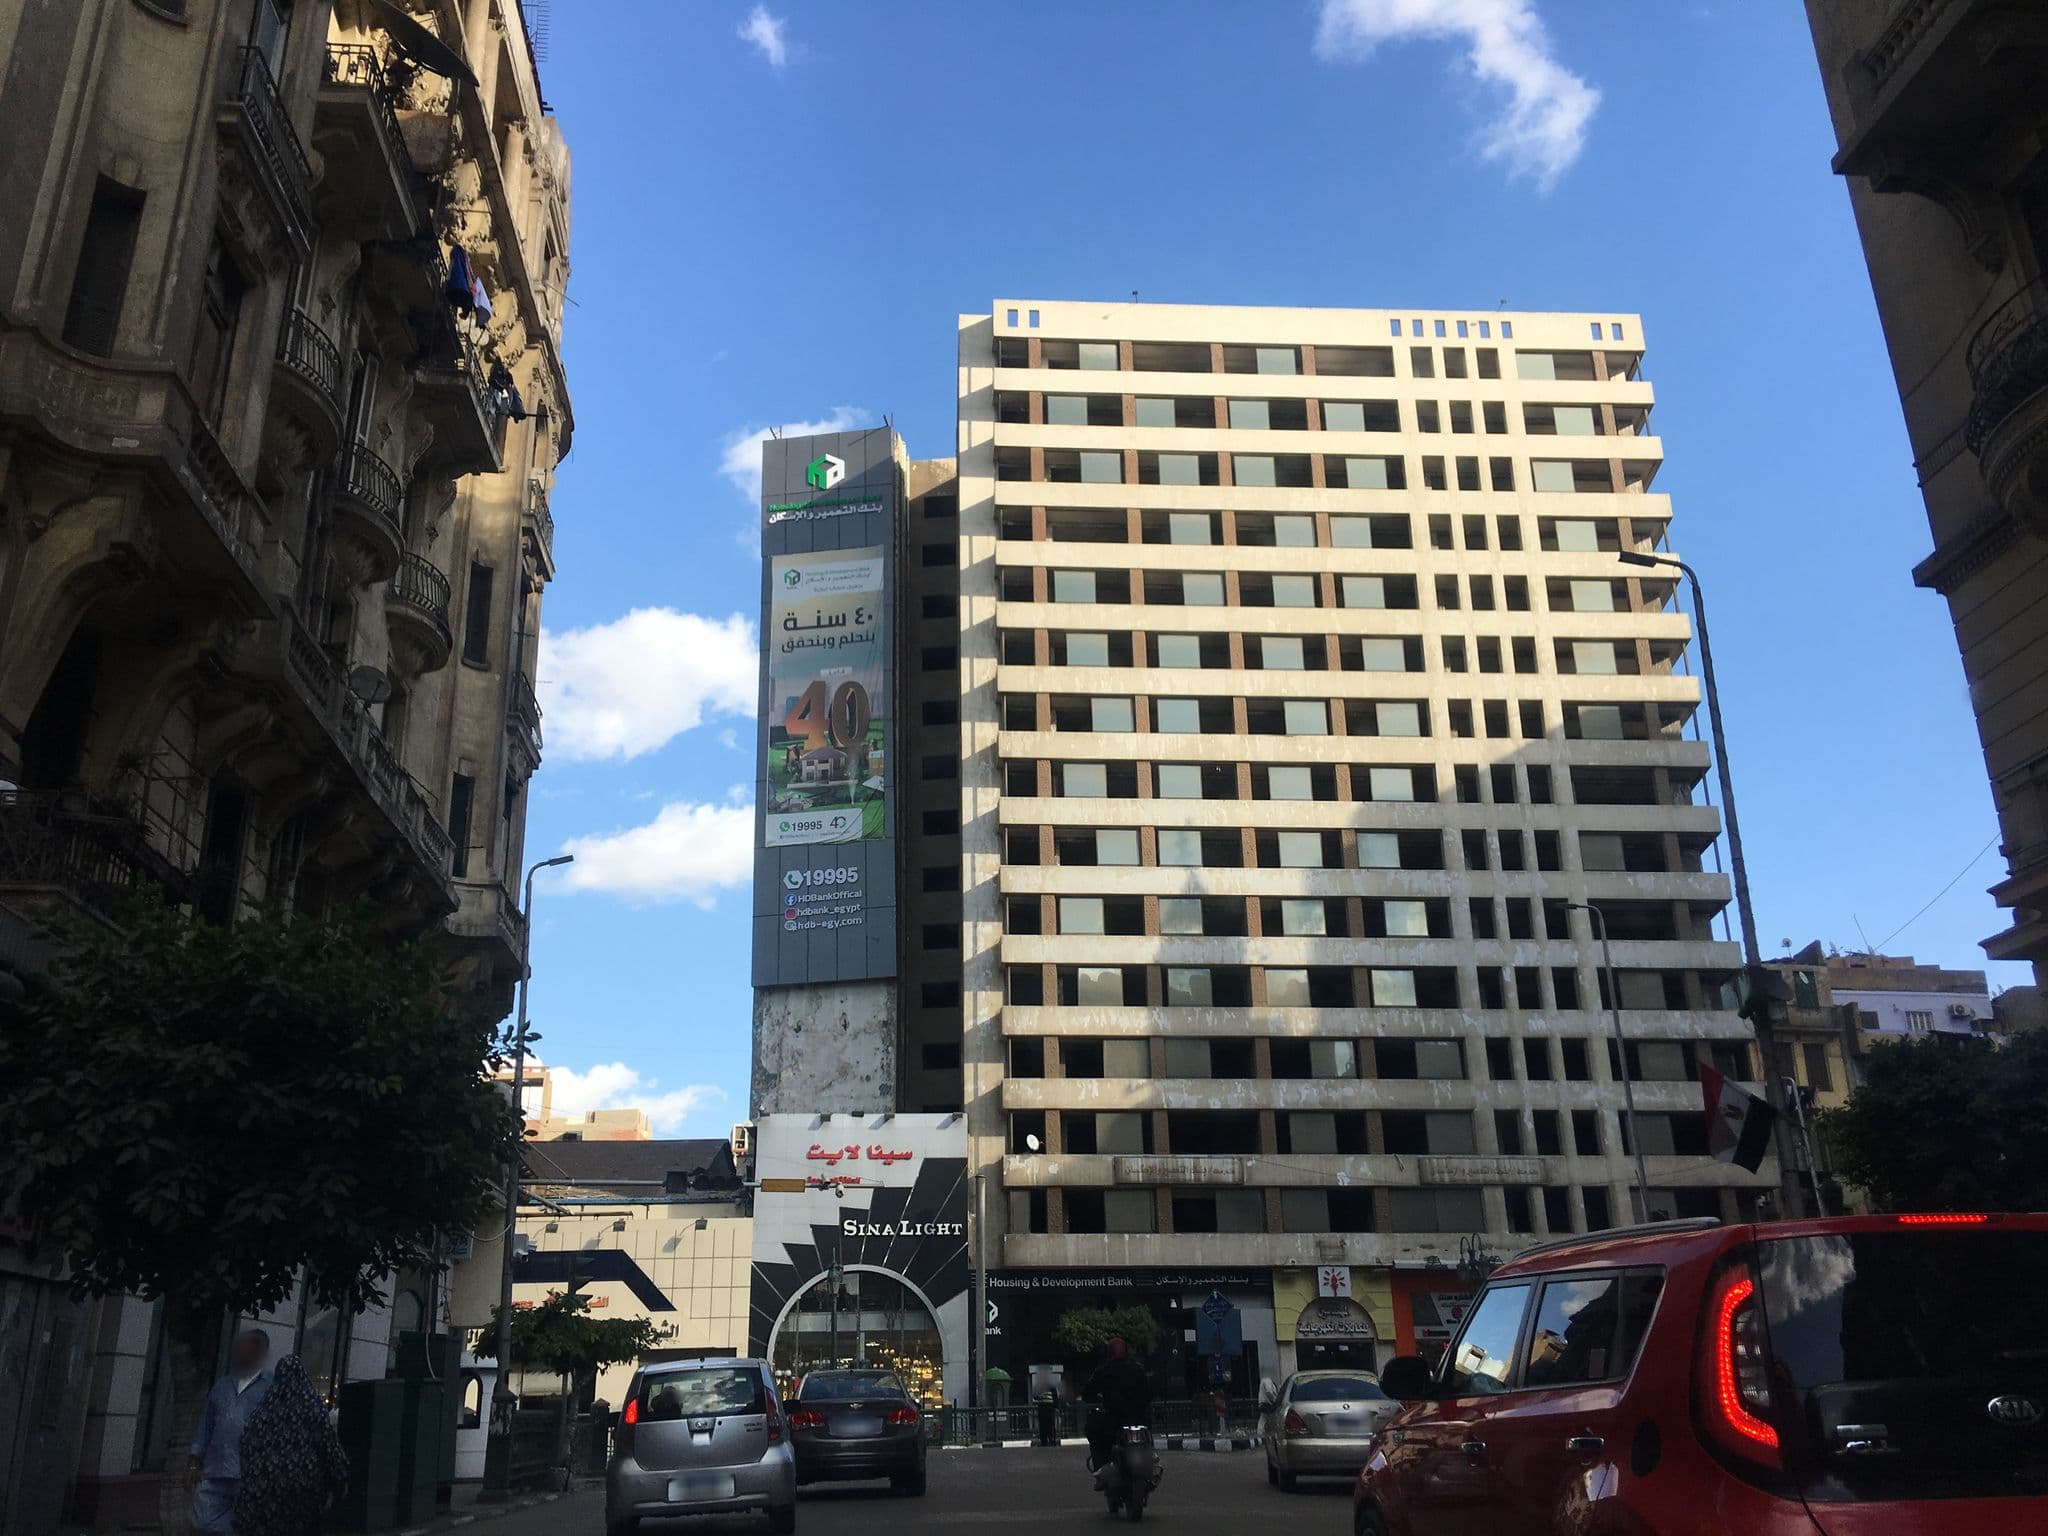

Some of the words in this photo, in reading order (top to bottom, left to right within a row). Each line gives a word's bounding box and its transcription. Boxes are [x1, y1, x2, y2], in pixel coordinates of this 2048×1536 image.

[814, 505, 856, 520] التعمير
[856, 504, 883, 514] بنك
[783, 609, 847, 632] سنة
[781, 635, 836, 654] وبنحقق
[838, 631, 876, 649] بنحلم
[791, 820, 823, 832] 19995
[803, 867, 859, 887] 19995
[797, 904, 861, 917] hdbank_egypt
[797, 918, 863, 930] hdb-egy.com
[806, 1143, 861, 1166] لايت
[866, 1144, 913, 1166] سينا
[989, 1277, 1030, 1289] Housing
[1032, 1277, 1040, 1287] &
[1042, 1276, 1106, 1288] Development
[1108, 1276, 1133, 1286] Bank
[1193, 1275, 1227, 1286] التعمير
[1228, 1275, 1249, 1285] بنك
